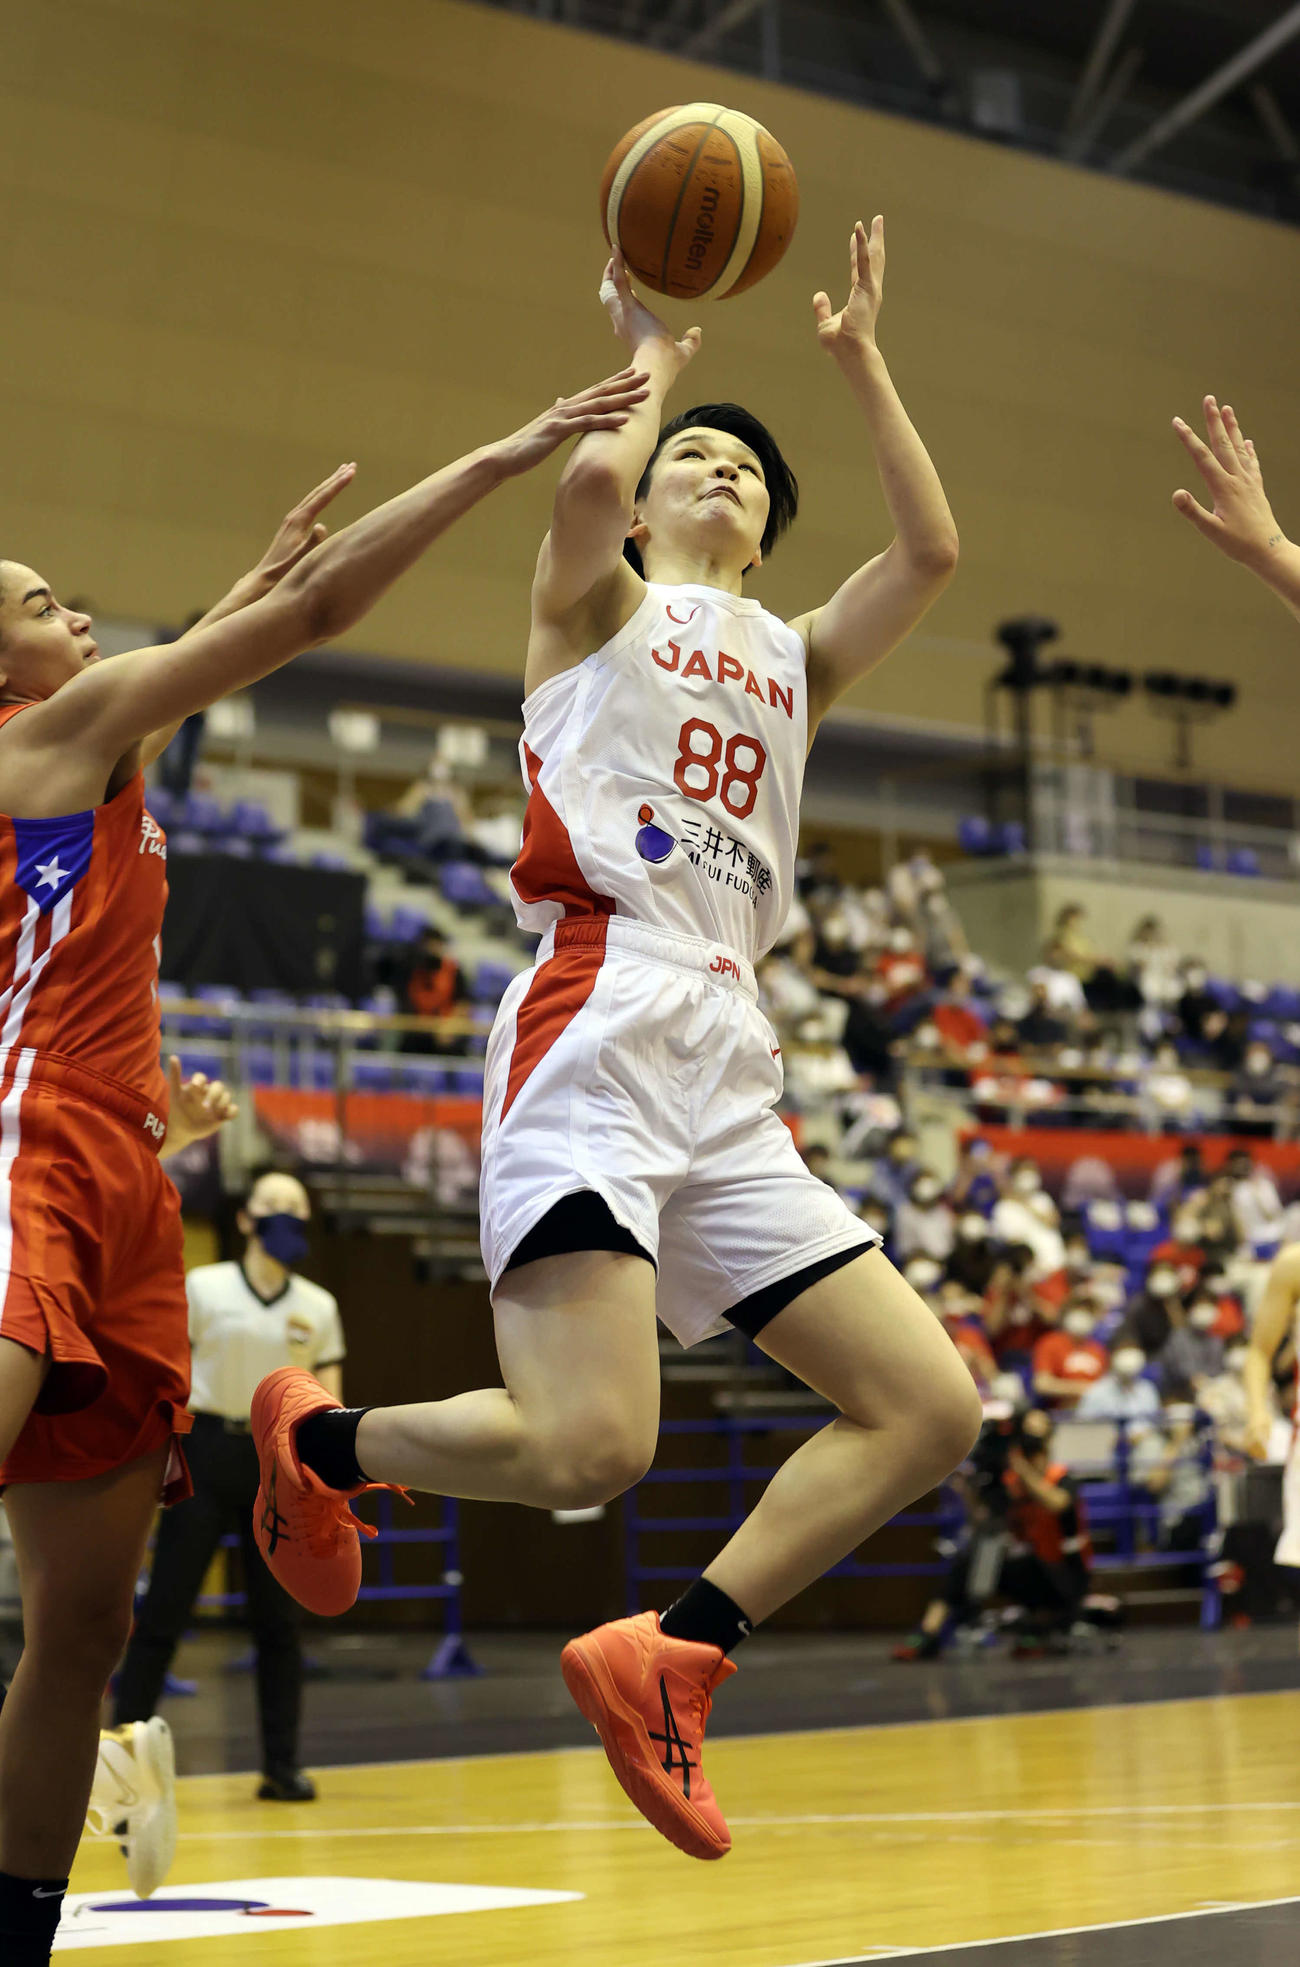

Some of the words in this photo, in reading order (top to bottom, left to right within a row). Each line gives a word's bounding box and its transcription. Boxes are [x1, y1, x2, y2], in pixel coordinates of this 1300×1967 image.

[685, 187, 721, 271] molten
[652, 640, 794, 720] JAPAN
[673, 717, 767, 820] 88
[709, 955, 741, 982] JPN
